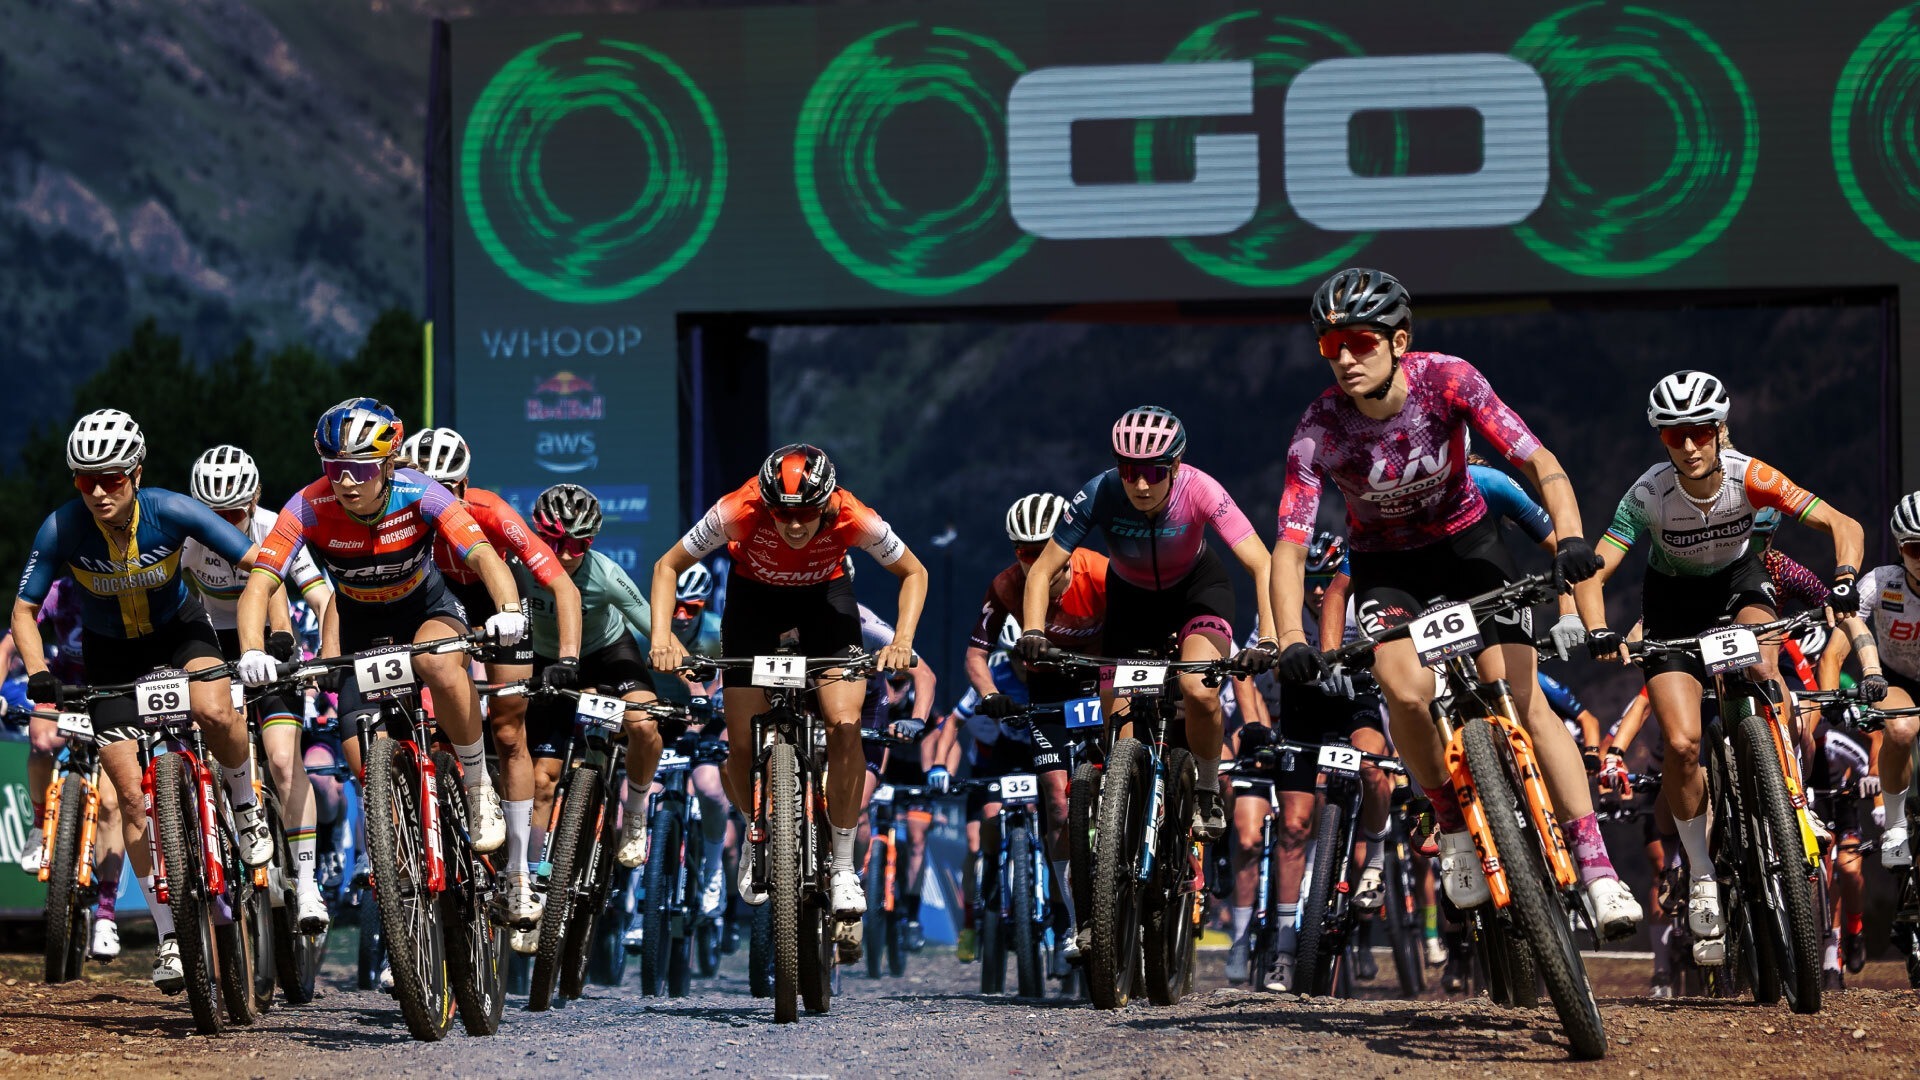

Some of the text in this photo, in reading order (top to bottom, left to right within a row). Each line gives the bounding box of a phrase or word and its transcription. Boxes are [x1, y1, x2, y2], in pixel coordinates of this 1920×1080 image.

[1008, 53, 1549, 239] GO
[480, 324, 643, 359] WHOOP
[536, 432, 596, 456] aws
[392, 485, 423, 494] TREK
[1371, 472, 1445, 500] FACTORY
[377, 511, 414, 530] SRAM
[1109, 522, 1193, 538] GHOST
[380, 525, 418, 545] ROCKSHOX
[1664, 519, 1750, 545] cannondale
[328, 539, 364, 549] Santini
[80, 545, 174, 573] CANYON
[93, 566, 168, 593] ROCKSHOX
[1423, 613, 1465, 639] 46
[1715, 632, 1738, 640] NEFF
[365, 647, 402, 657] WHOOP
[1722, 639, 1738, 656] 5
[145, 671, 180, 681] WHOOP
[367, 659, 403, 684] 13
[766, 661, 791, 674] 11
[1132, 669, 1148, 681] 8
[148, 692, 180, 711] 69
[590, 698, 617, 714] 18
[1073, 700, 1101, 723] 17
[1329, 751, 1354, 765] 12
[1008, 781, 1030, 793] 35
